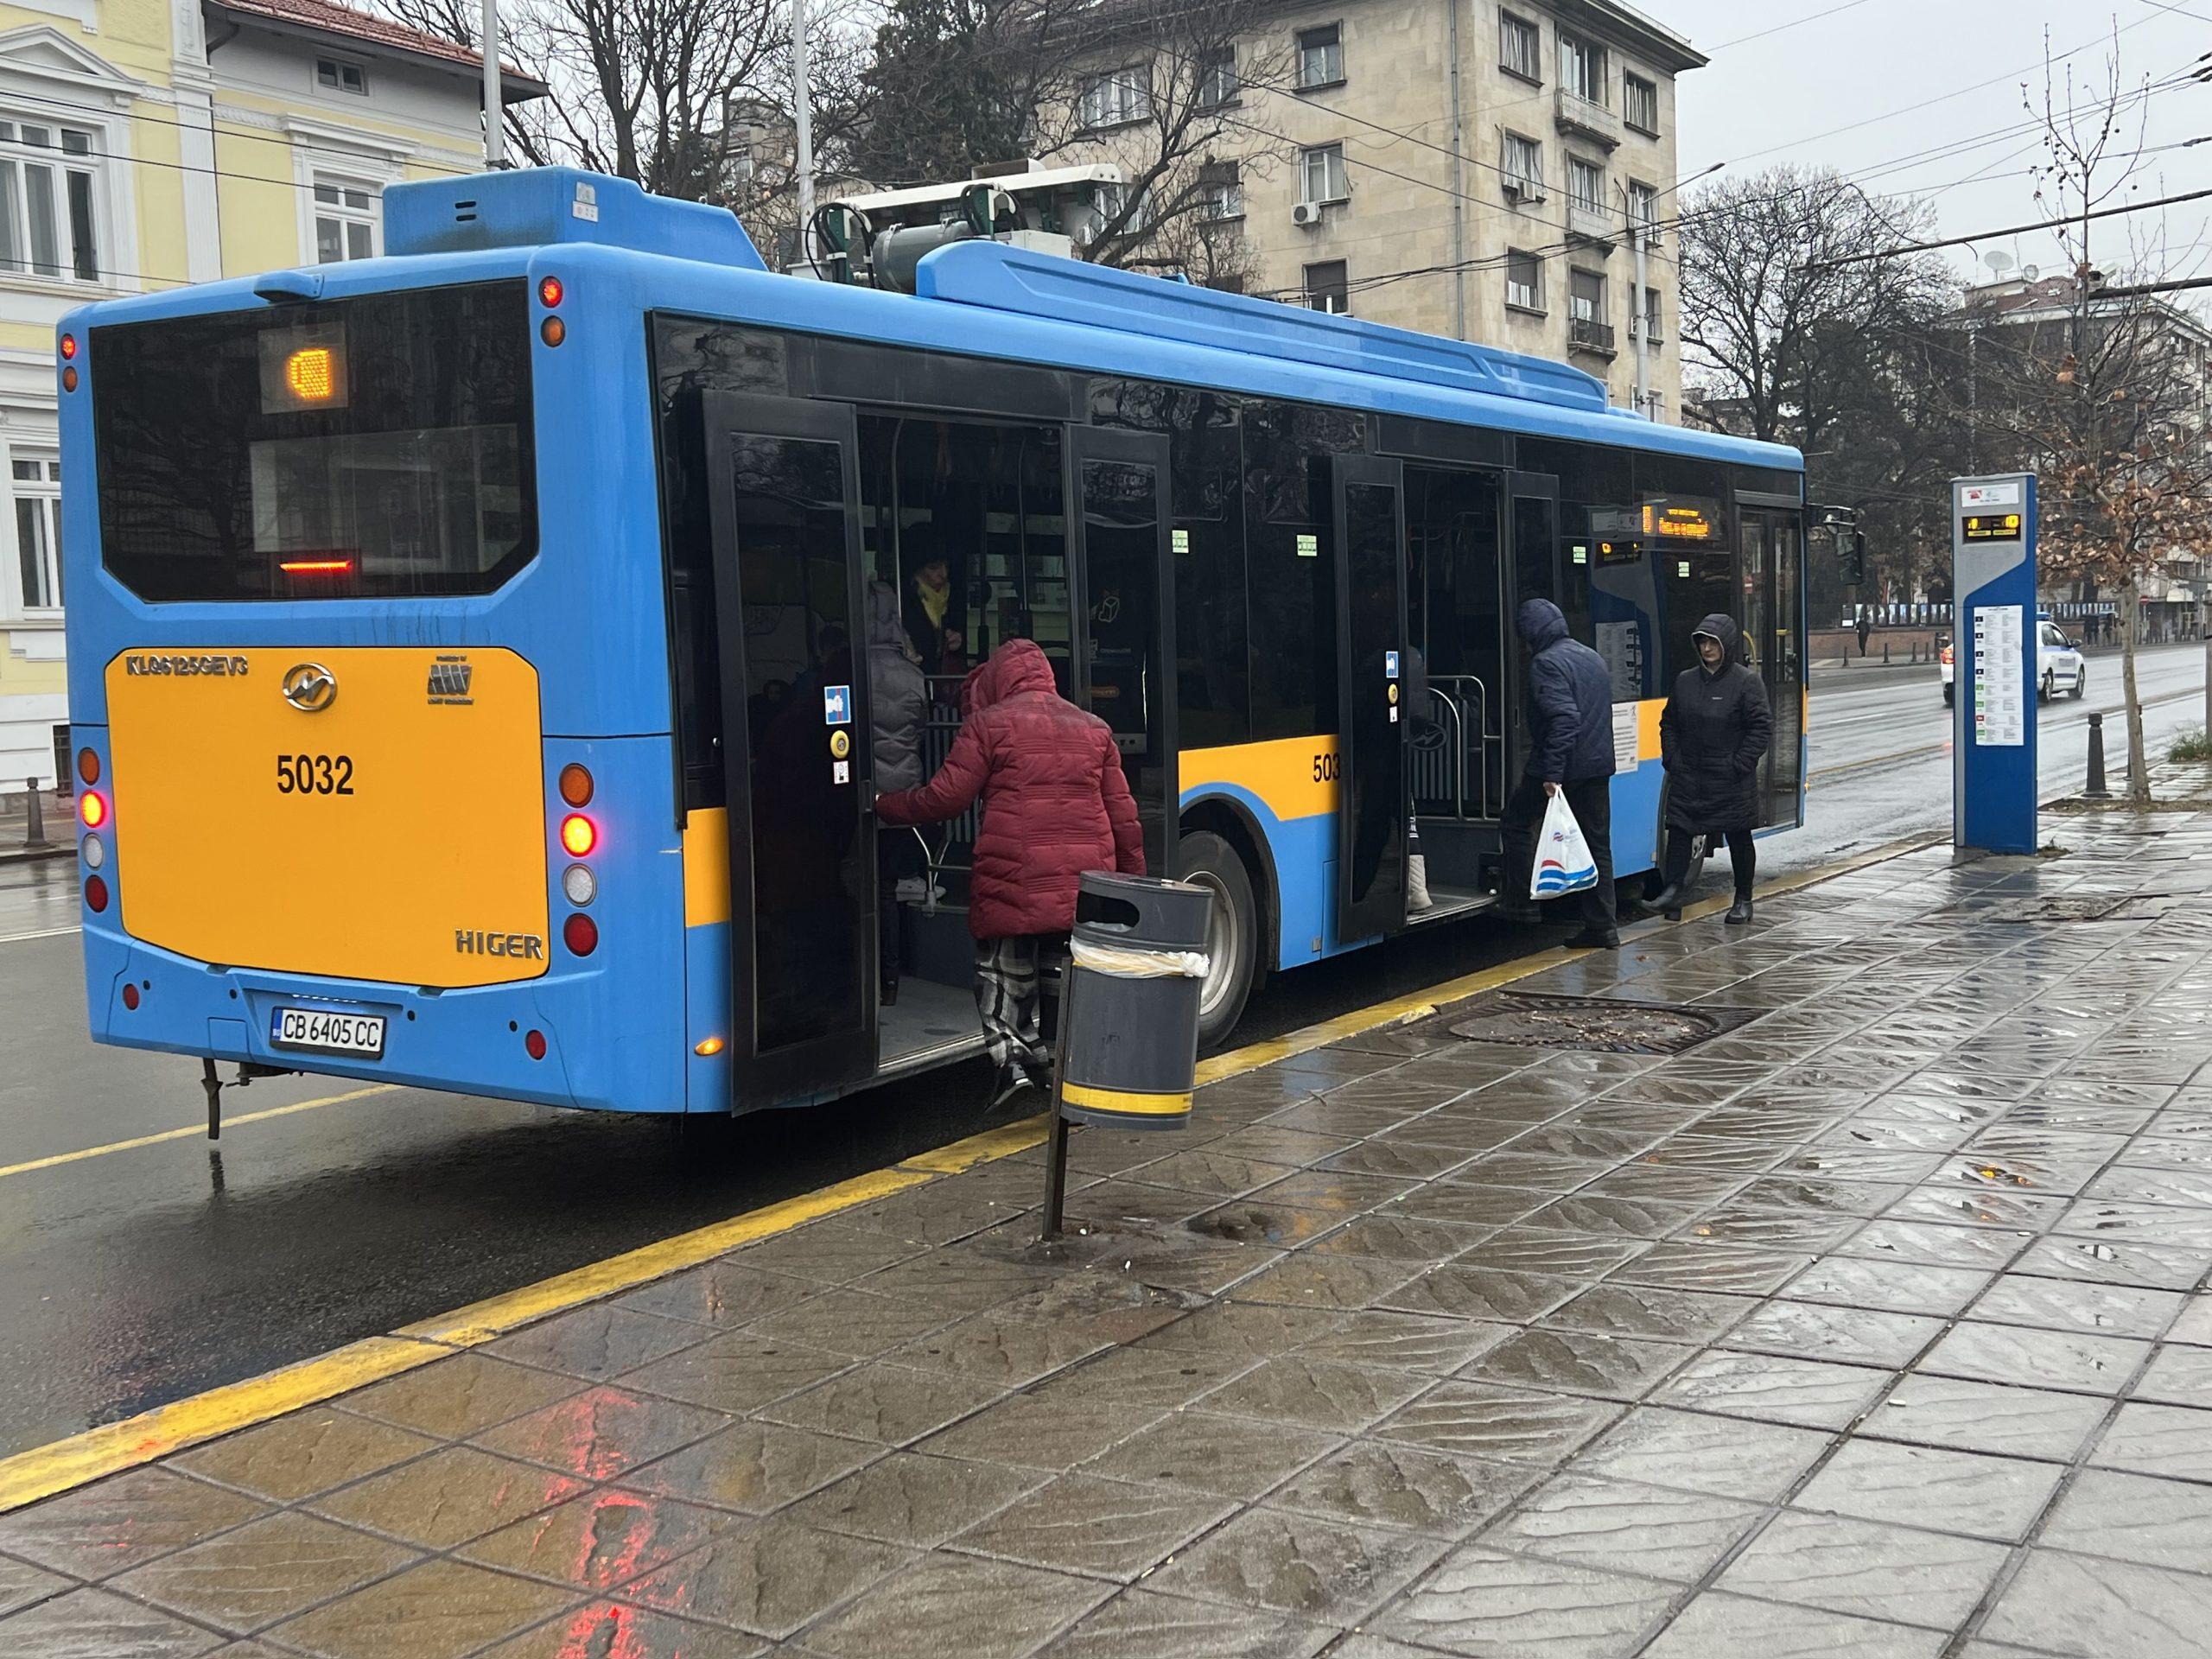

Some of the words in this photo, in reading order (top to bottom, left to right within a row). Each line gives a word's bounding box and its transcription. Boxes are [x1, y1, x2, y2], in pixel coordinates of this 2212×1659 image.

[277, 754, 353, 794] 5032
[1313, 753, 1341, 783] 503
[455, 929, 543, 960] HIGER
[283, 1014, 306, 1039] CB
[310, 1016, 352, 1045] 6405
[355, 1020, 379, 1047] CC
